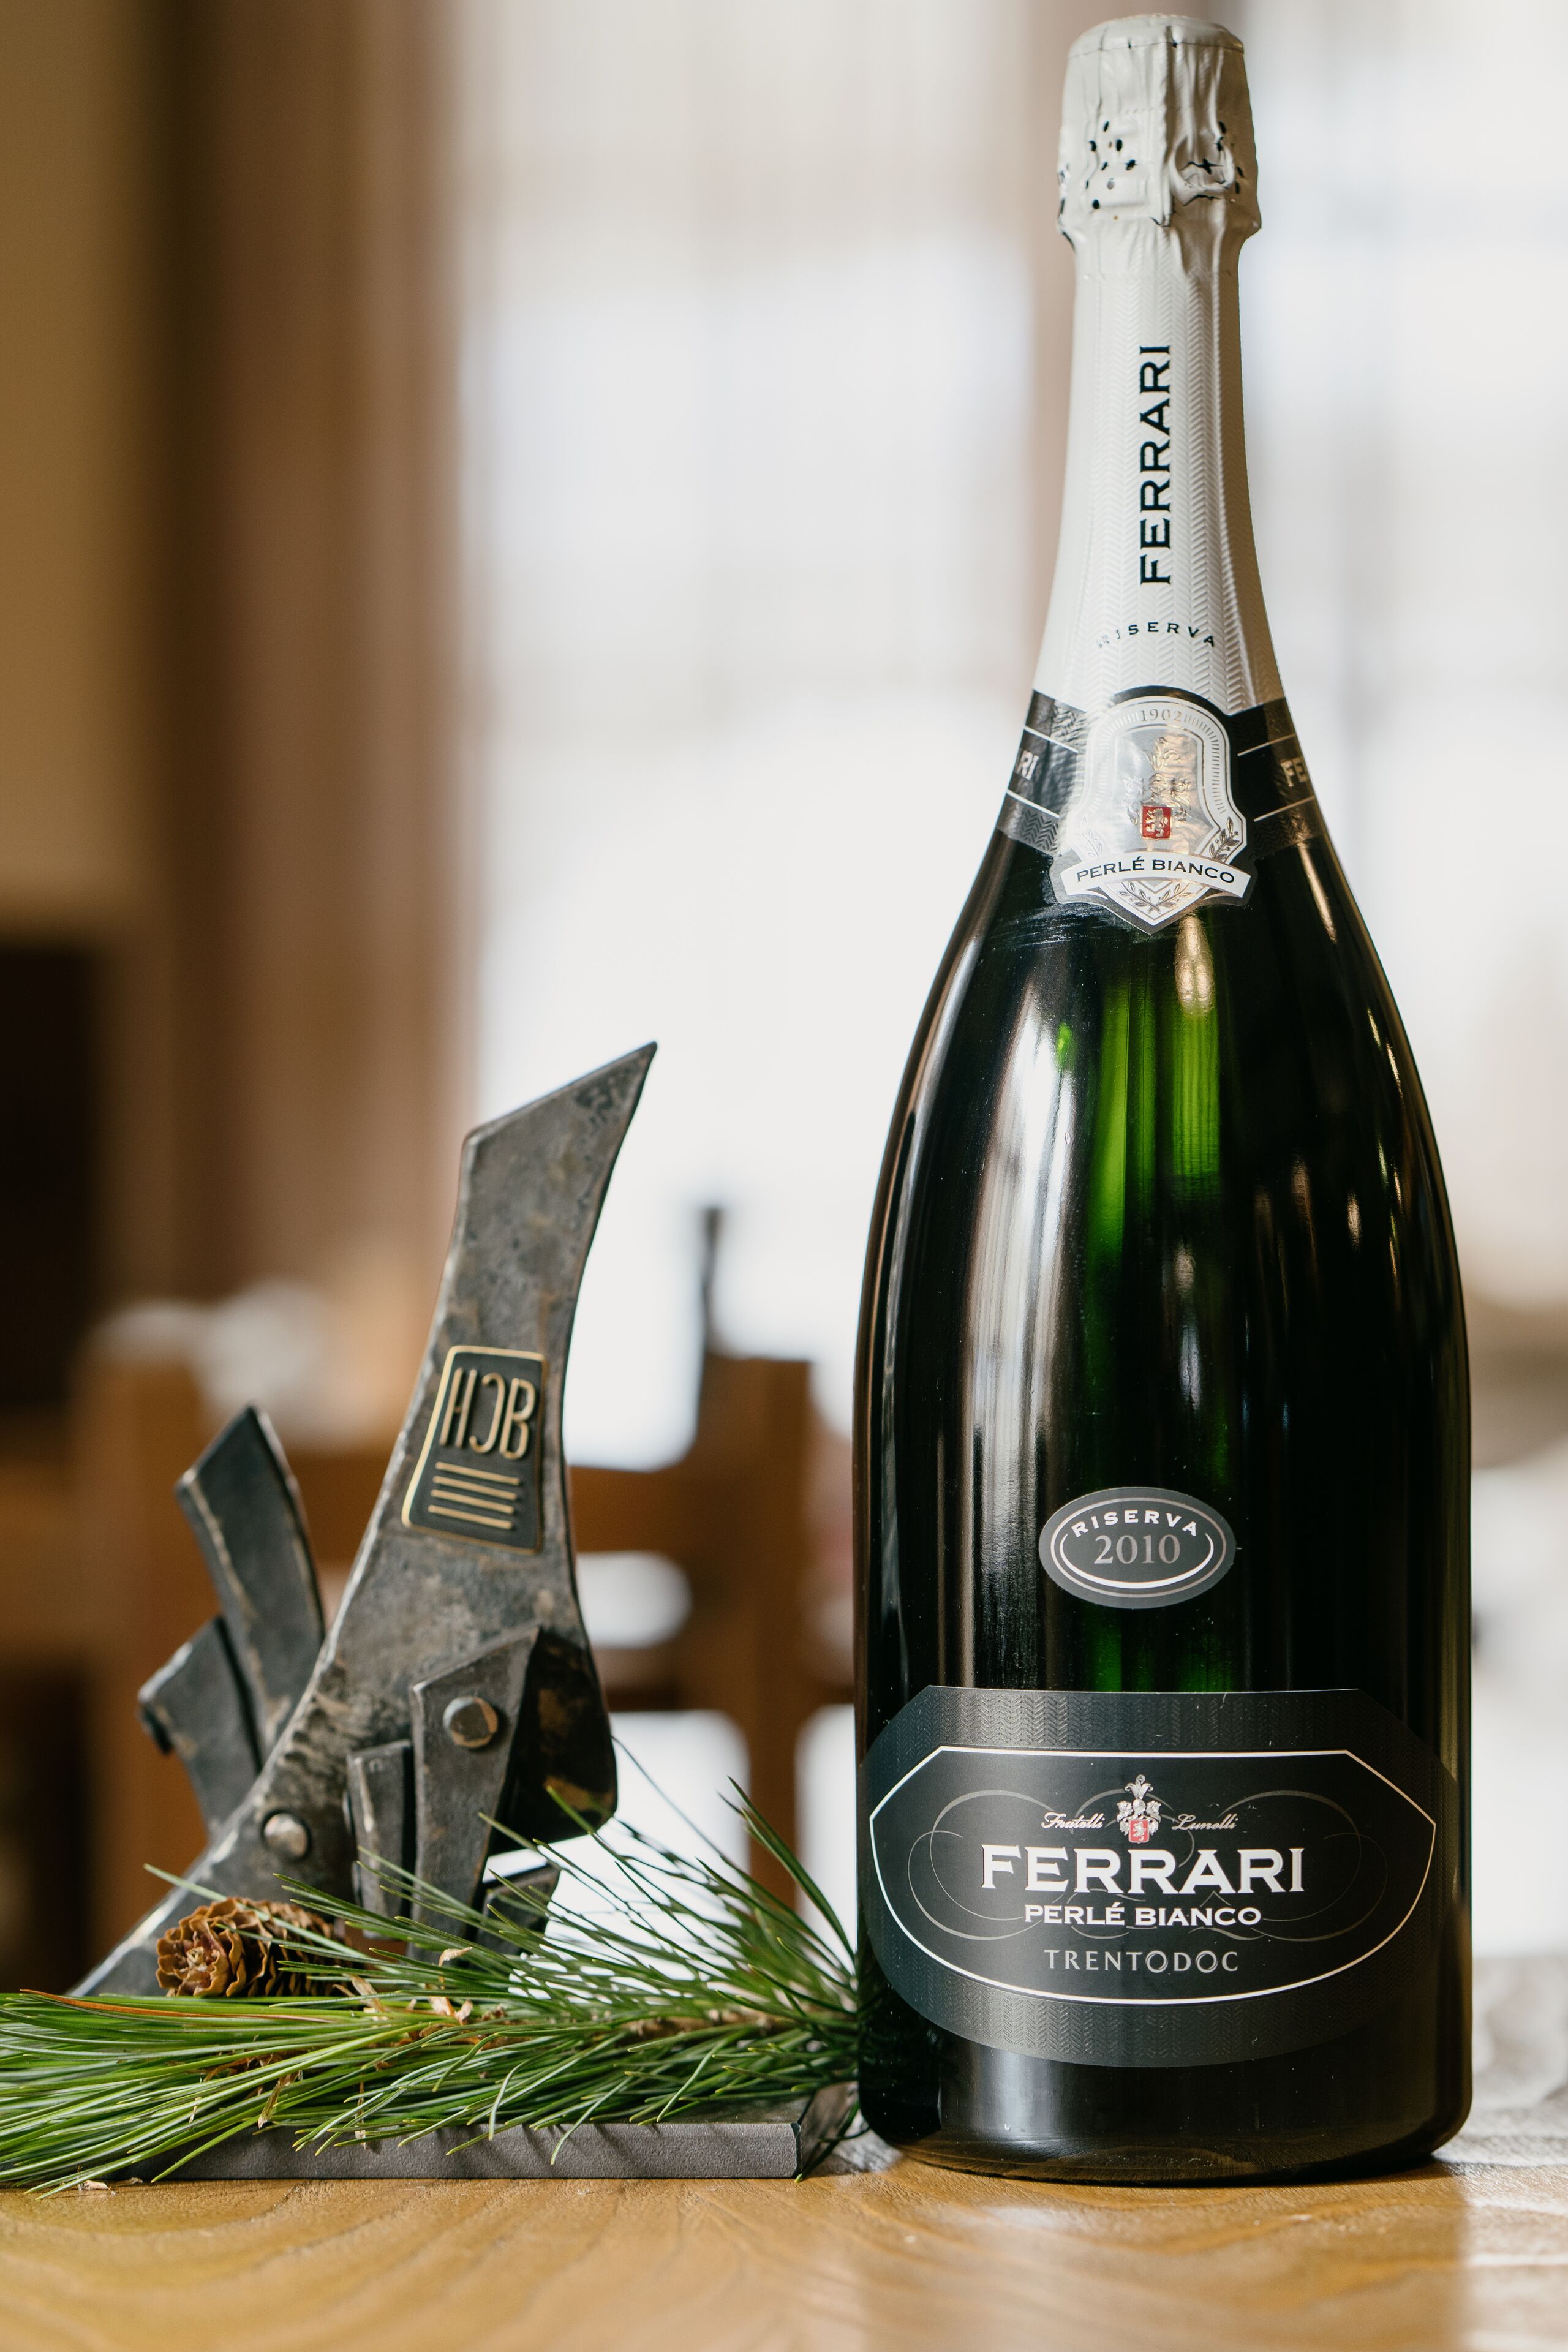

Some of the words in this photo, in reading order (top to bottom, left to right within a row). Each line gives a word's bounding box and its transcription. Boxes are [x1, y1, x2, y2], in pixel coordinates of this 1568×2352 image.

[1139, 345, 1170, 585] FERRARI
[1140, 709, 1182, 722] 1902
[1076, 856, 1145, 883] PERLÉ
[1152, 859, 1235, 884] BIANCO
[1071, 1509, 1197, 1538] RISERVA
[1094, 1534, 1181, 1564] 2010
[1041, 1811, 1106, 1830] Fratelli
[1171, 1813, 1239, 1831] Lunelli
[981, 1844, 1305, 1894] FERRARI
[1024, 1901, 1125, 1926] PERLÉ
[1134, 1906, 1262, 1927] BIANCO
[1044, 1948, 1239, 1974] TRENTODOC
